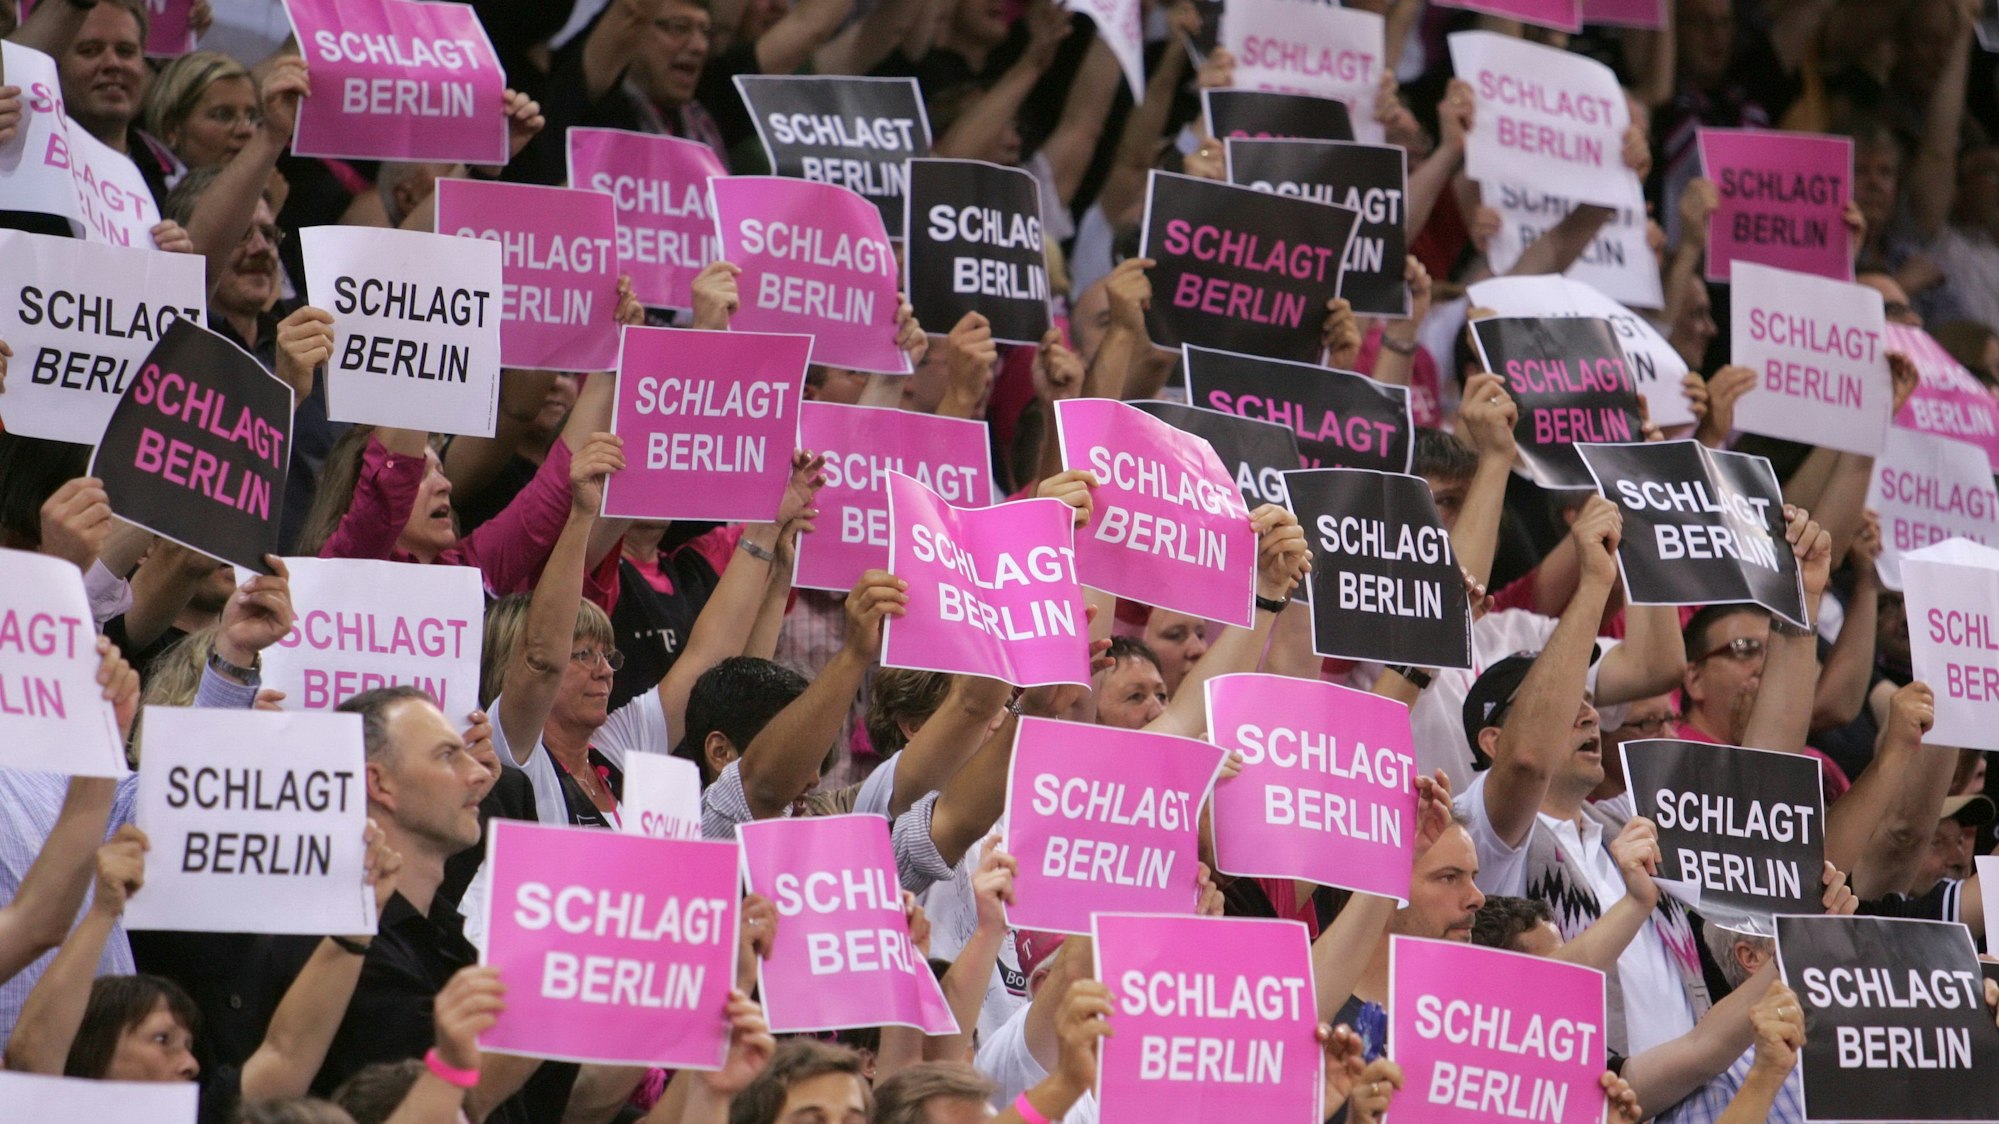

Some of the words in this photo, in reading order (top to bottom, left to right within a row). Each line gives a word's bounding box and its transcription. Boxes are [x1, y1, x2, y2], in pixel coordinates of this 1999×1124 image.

[314, 29, 481, 70] SCHLAGT
[1241, 35, 1375, 83] SCHLAGT
[342, 79, 474, 117] BERLIN
[1478, 70, 1614, 127] SCHLAGT
[768, 113, 914, 150] SCHLAGT
[1497, 116, 1603, 168] BERLIN
[1719, 168, 1842, 206] SCHLAGT
[456, 227, 610, 275] HLAGT
[740, 218, 889, 278] SCHLAGT
[1164, 219, 1333, 282] SCHLAGT
[1732, 213, 1828, 248] BERLIN
[334, 276, 490, 328] SCHLAGT
[757, 273, 875, 327] BERLIN
[1173, 272, 1306, 328] BERLIN
[340, 334, 470, 383] BERLIN
[1750, 308, 1879, 363] SCHLAGT
[635, 376, 789, 420] SCHLAGT
[1506, 359, 1630, 395] SCHLAGT
[1766, 359, 1863, 409] BERLIN
[134, 363, 285, 470] SCHLAGT
[1534, 408, 1627, 444] BERLIN
[1912, 397, 1996, 437] BERLIN
[134, 427, 272, 521] BERLIN
[646, 433, 766, 473] BERLIN
[1089, 446, 1237, 519] SCHLAGT
[1616, 479, 1769, 531] SCHLAGT
[1880, 467, 1997, 522] SCHLAGT
[911, 523, 1077, 591] SCHLAGT
[1095, 506, 1227, 571] BERLIN
[1317, 515, 1453, 567] SCHLAGT
[1654, 525, 1779, 573] BERLIN
[939, 583, 1076, 641] BERLIN
[1339, 571, 1442, 620] BERLIN
[1235, 723, 1414, 794] SCHLAGT
[166, 767, 354, 813] SCHLAGT
[1032, 773, 1192, 832] SCHLAGT
[1265, 784, 1402, 848] BERLIN
[1655, 788, 1815, 844] SCHLAGT
[182, 832, 331, 876] BERLIN
[1042, 836, 1175, 889] BERLIN
[1677, 848, 1801, 899] BERLIN
[514, 883, 727, 945] SCHLAGT
[541, 951, 705, 1010] BERLIN
[1006, 970, 1027, 986] Bo
[1120, 970, 1305, 1021] SCHLAGT
[1803, 967, 1978, 1009] SCHLAGT
[1414, 994, 1597, 1066] SCHLAGT
[1836, 1027, 1972, 1069] BERLIN
[1140, 1037, 1284, 1083] BERLIN
[1428, 1060, 1568, 1123] BERLIN
